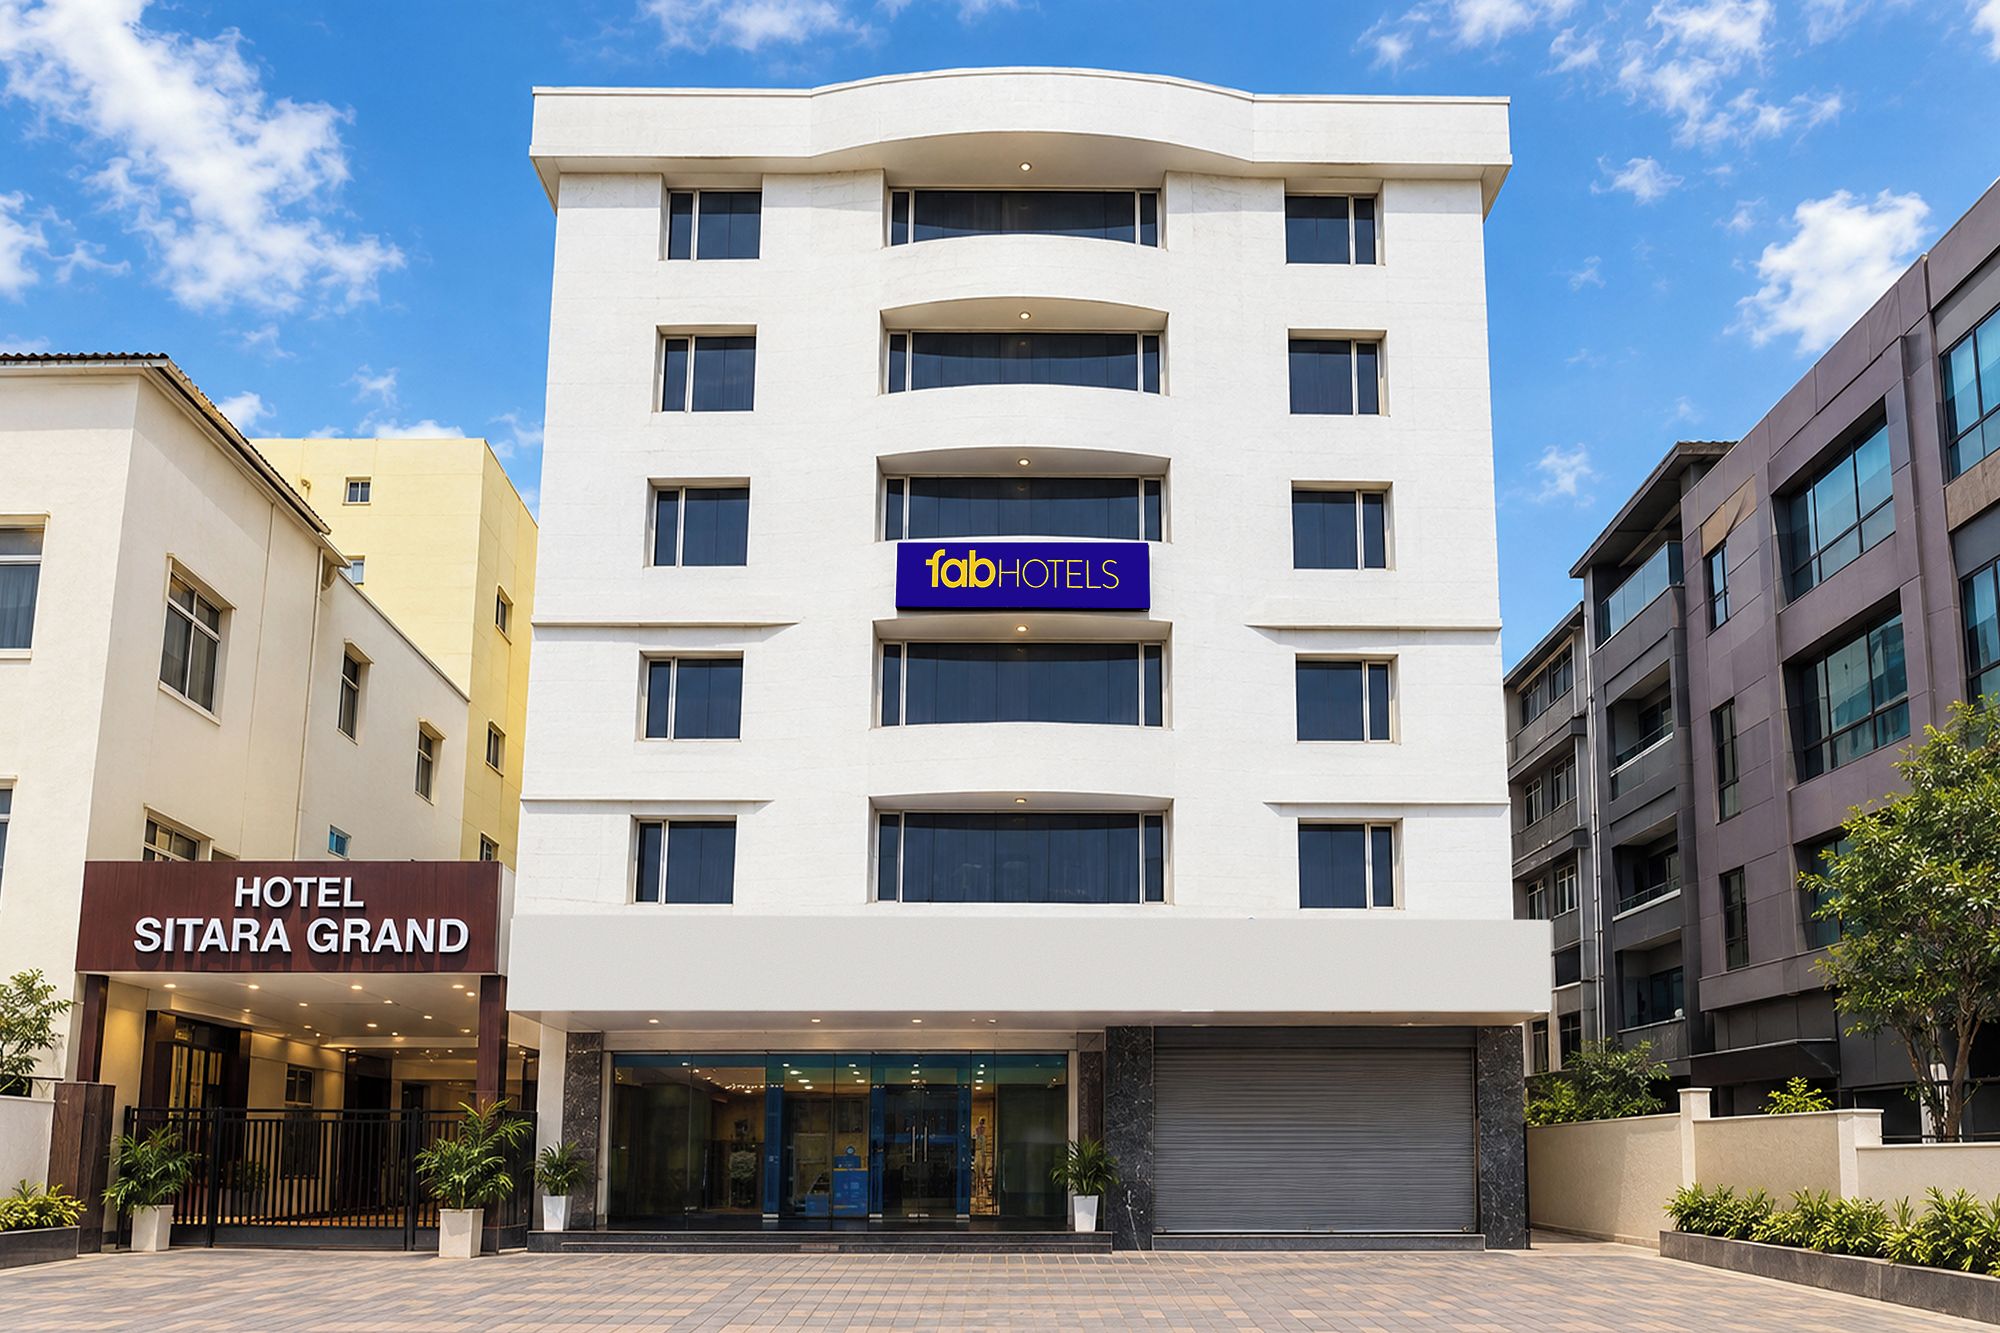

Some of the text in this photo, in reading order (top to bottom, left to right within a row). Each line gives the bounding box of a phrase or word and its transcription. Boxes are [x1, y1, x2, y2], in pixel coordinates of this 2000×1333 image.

[234, 876, 364, 908] HOTEL
[134, 917, 469, 954] SITARA GRAND
